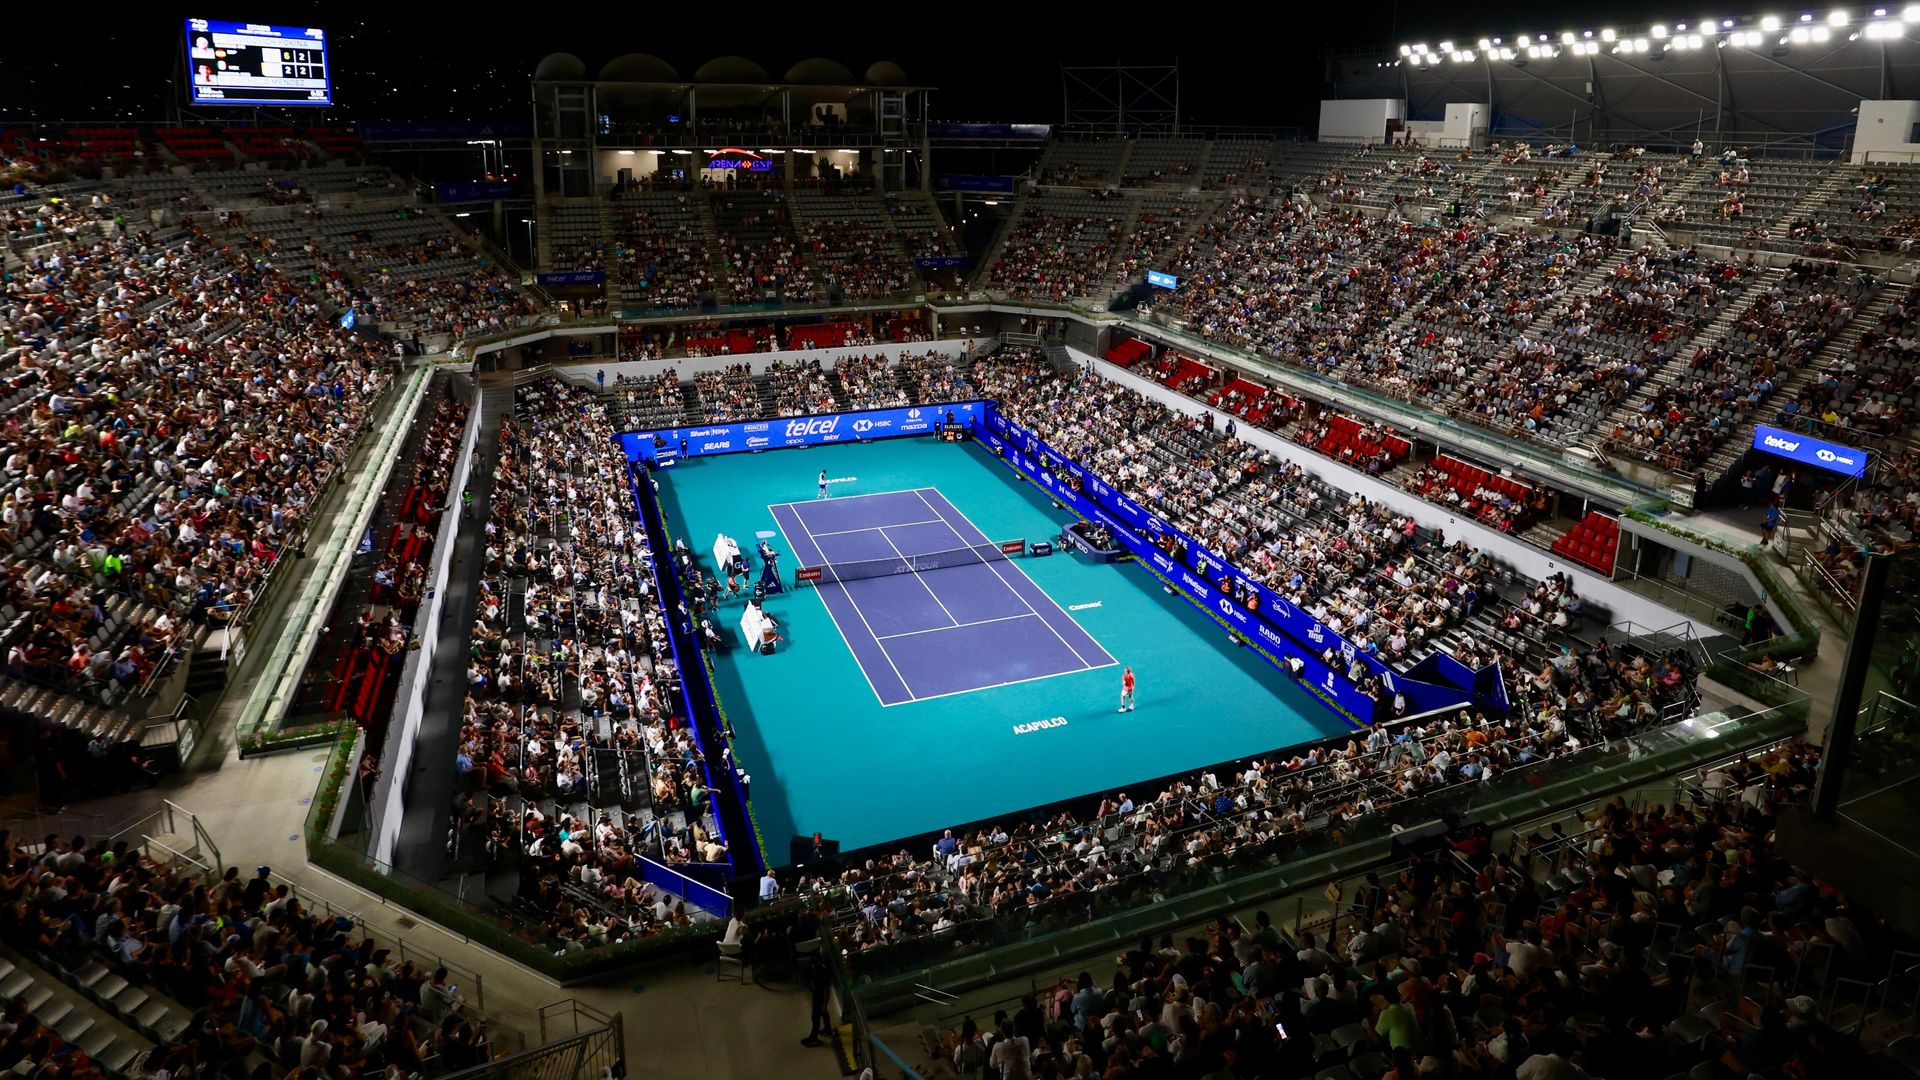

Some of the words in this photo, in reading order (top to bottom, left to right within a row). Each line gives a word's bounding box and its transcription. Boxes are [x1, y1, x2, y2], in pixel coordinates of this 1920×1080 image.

[283, 51, 291, 60] 6
[298, 53, 305, 61] 2
[285, 66, 291, 74] 2
[299, 67, 306, 75] 2
[708, 160, 741, 168] ARENA
[743, 423, 769, 431] PRINCESS
[785, 416, 840, 437] telcel
[901, 423, 928, 431] mazda
[823, 433, 840, 441] telcel
[704, 441, 730, 450] SEARS
[1764, 435, 1800, 452] telcel
[1233, 609, 1247, 624] HSBC
[1259, 624, 1281, 645] RADO
[1012, 716, 1068, 735] ACAPULCO
